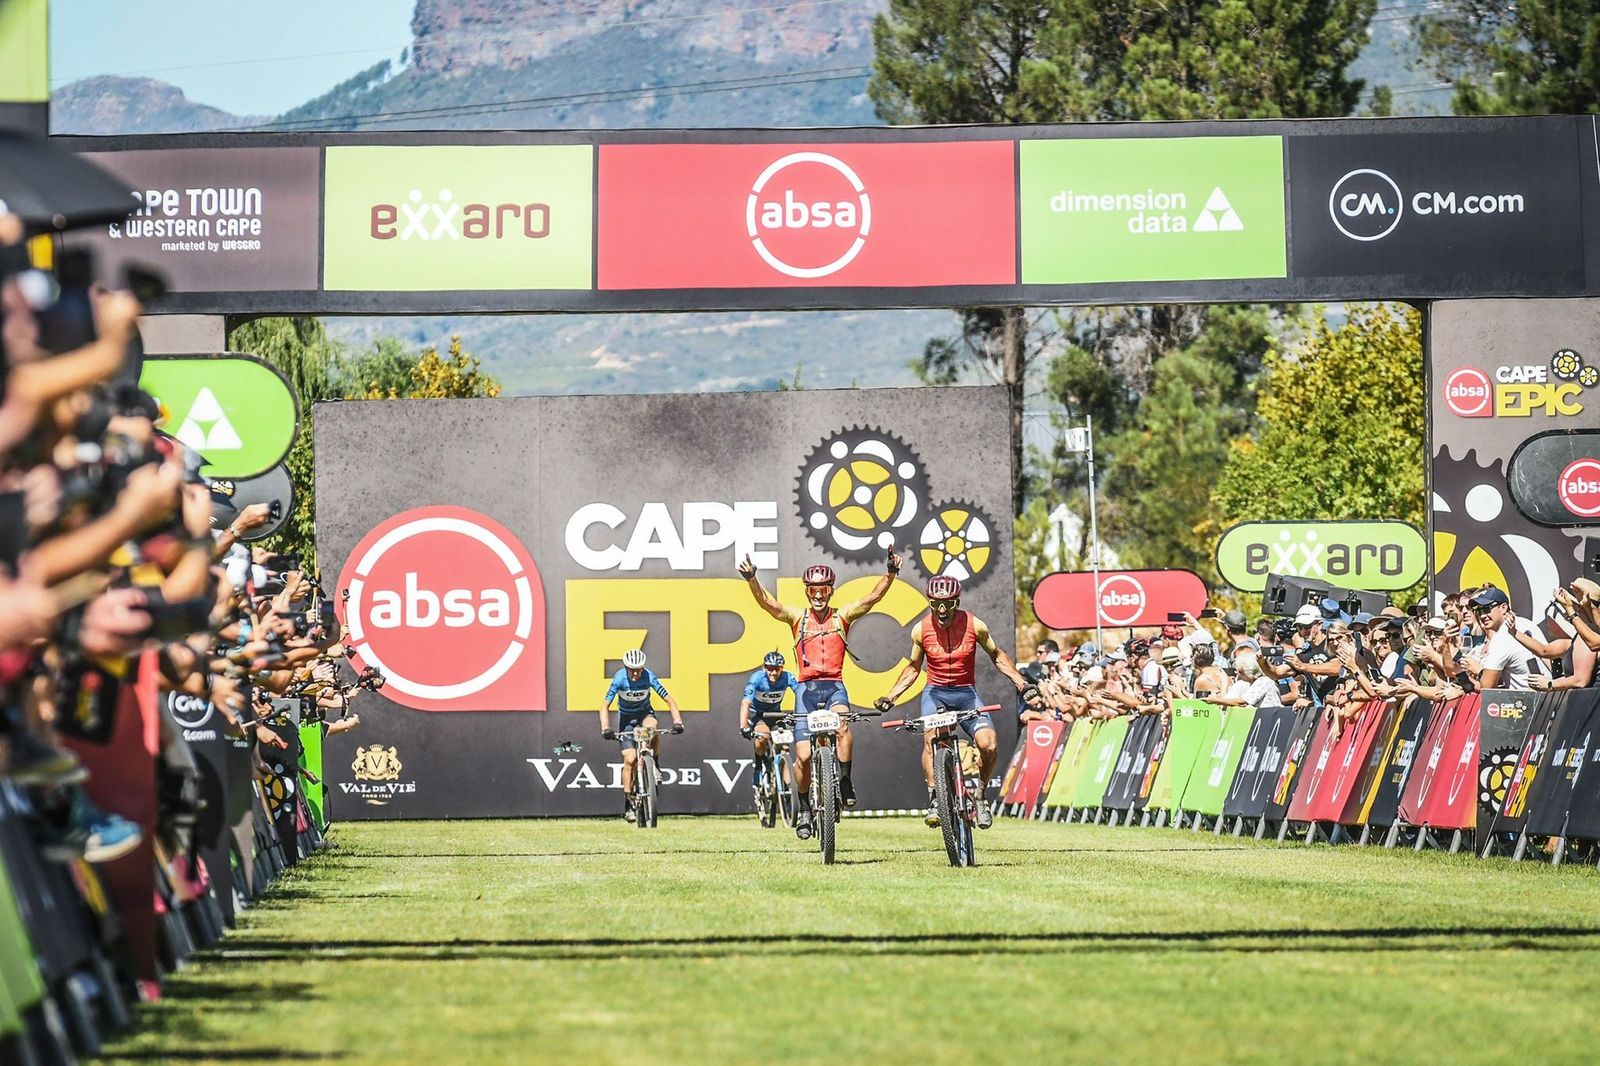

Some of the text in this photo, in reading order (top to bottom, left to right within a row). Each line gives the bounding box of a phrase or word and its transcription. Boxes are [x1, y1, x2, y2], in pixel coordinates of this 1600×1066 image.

[761, 189, 857, 229] absa
[1050, 189, 1187, 214] dimension
[1411, 191, 1525, 214] CM.com
[370, 189, 551, 241] exxaro
[1128, 213, 1188, 233] data
[108, 223, 122, 238] &
[161, 240, 206, 251] marketed
[207, 241, 219, 252] by
[1495, 366, 1548, 383] CAPE
[1450, 384, 1484, 397] absa
[1496, 384, 1584, 417] EPIC
[564, 502, 778, 570] CAPE
[1246, 530, 1403, 576] exxaro
[370, 571, 510, 628] absa
[1101, 590, 1140, 607] absa
[1175, 708, 1210, 718] earo
[1500, 709, 1523, 718] EPIC
[810, 720, 839, 729] 408-2
[339, 783, 371, 794] VAL
